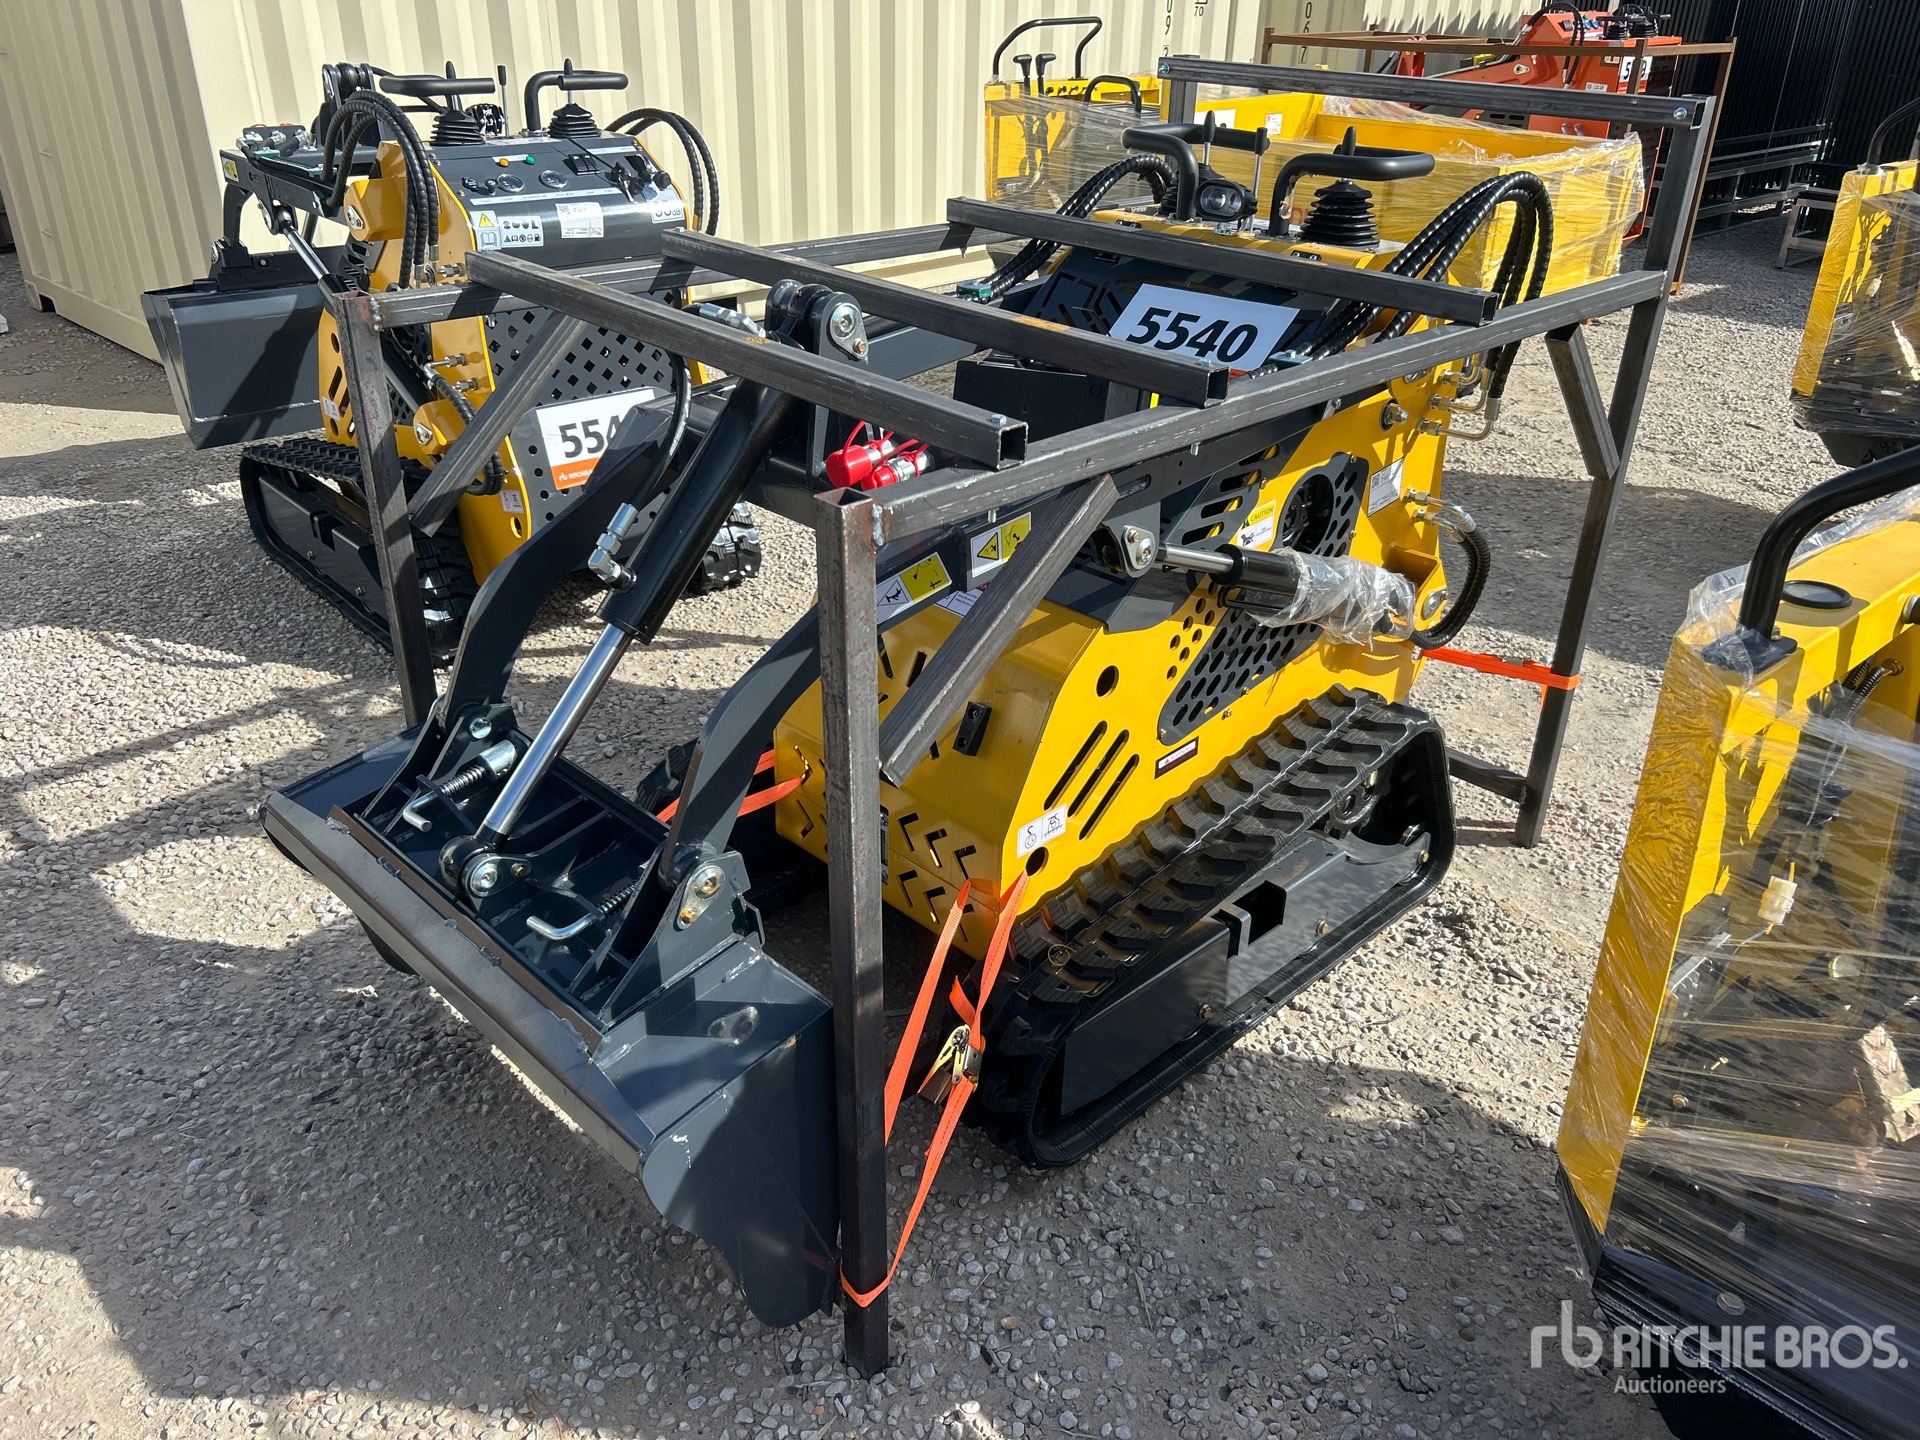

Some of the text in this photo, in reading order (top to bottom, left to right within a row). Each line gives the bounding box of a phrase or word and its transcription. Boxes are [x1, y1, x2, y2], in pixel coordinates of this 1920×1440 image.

[1194, 6, 1204, 17] 70
[1125, 307, 1258, 363] 5540
[559, 415, 621, 459] 554
[1250, 505, 1274, 521] CAUTION
